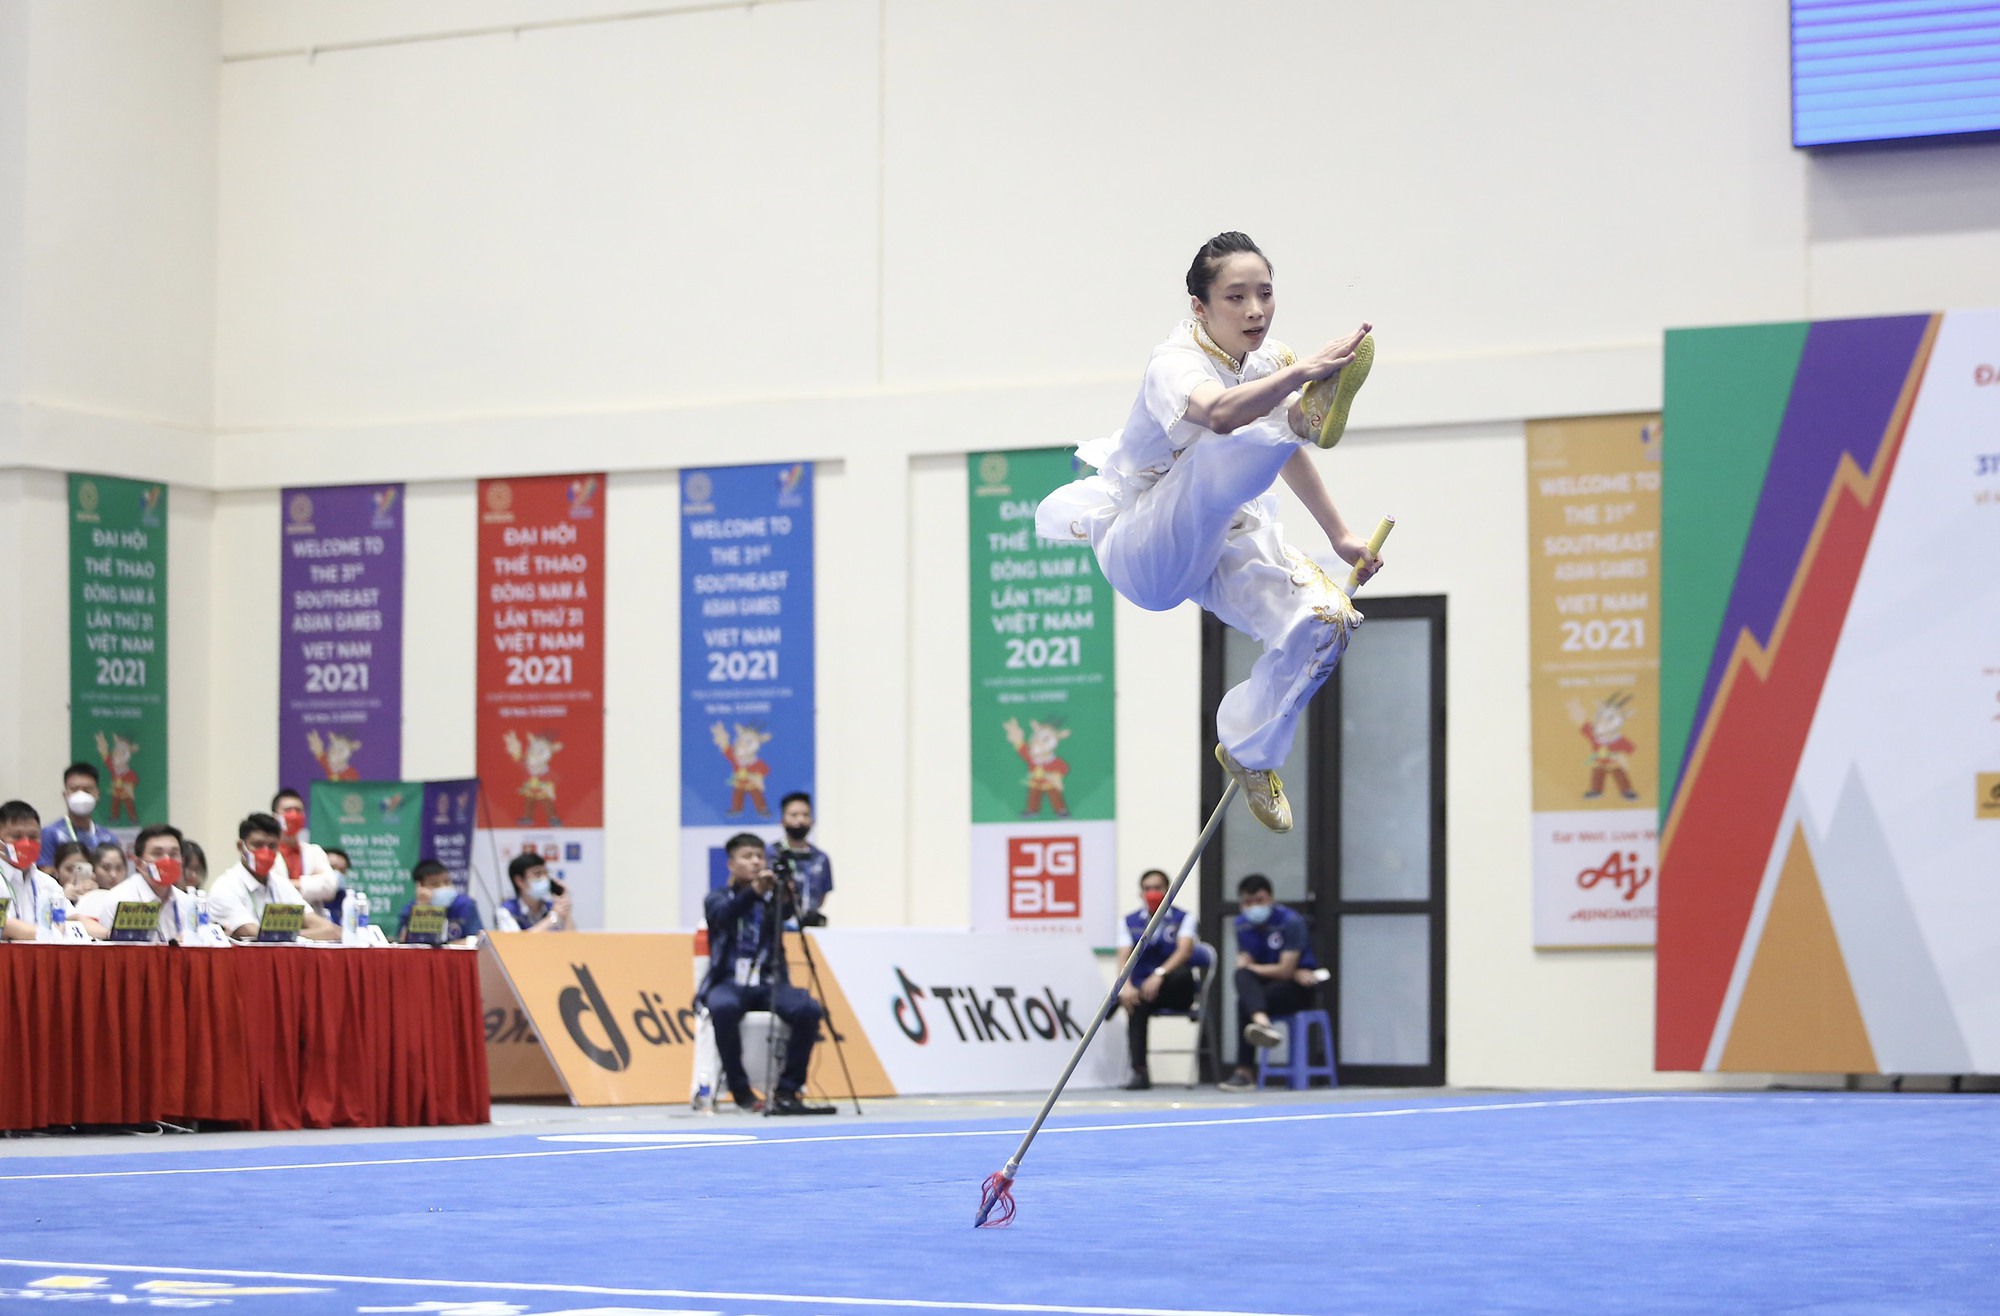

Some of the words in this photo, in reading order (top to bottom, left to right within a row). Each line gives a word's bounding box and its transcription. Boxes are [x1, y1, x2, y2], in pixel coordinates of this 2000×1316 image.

[1539, 473, 1630, 496] WELCOME
[1635, 470, 1659, 491] TO
[1564, 505, 1598, 525] THE
[542, 523, 576, 546] HỘI
[690, 518, 767, 539] WELCOME
[771, 516, 791, 535] TO
[292, 538, 361, 558] WELCOME
[365, 537, 384, 555] TO
[1544, 531, 1656, 556] SOUTHEAST
[534, 555, 586, 575] THAO
[711, 547, 740, 565] THE
[1040, 558, 1075, 577] NAM
[1079, 554, 1091, 575] Á
[117, 560, 154, 579] THAO
[311, 565, 337, 583] THE
[1555, 563, 1595, 581] ASIAN
[1600, 560, 1647, 579] GAMES
[539, 582, 571, 600] NAM
[575, 580, 587, 599] Á
[694, 571, 788, 593] SOUTHEAST
[121, 587, 145, 603] NAM
[295, 588, 379, 609] SOUTHEAST
[1075, 586, 1092, 604] 31
[1603, 593, 1647, 610] NAM
[703, 599, 737, 617] ASIAN
[741, 597, 781, 615] GAMES
[293, 613, 332, 633] ASIAN
[335, 611, 382, 631] GAMES
[568, 609, 583, 627] 31
[992, 612, 1039, 634] VIỆT
[1044, 613, 1093, 630] NAM
[122, 636, 154, 653] NAM
[494, 632, 535, 653] VIỆT
[540, 633, 583, 649] NAM
[743, 628, 781, 645] NAM
[1562, 619, 1644, 651] 2021
[303, 642, 334, 660] VIET
[338, 641, 371, 659] NAM
[1006, 637, 1080, 668] 2021
[97, 659, 145, 686] 2021
[506, 656, 571, 685] 2021
[708, 651, 778, 681] 2021
[306, 664, 368, 693] 2021
[1013, 843, 1075, 876] JG
[1014, 881, 1075, 912] BL
[931, 986, 1084, 1041] TikTok
